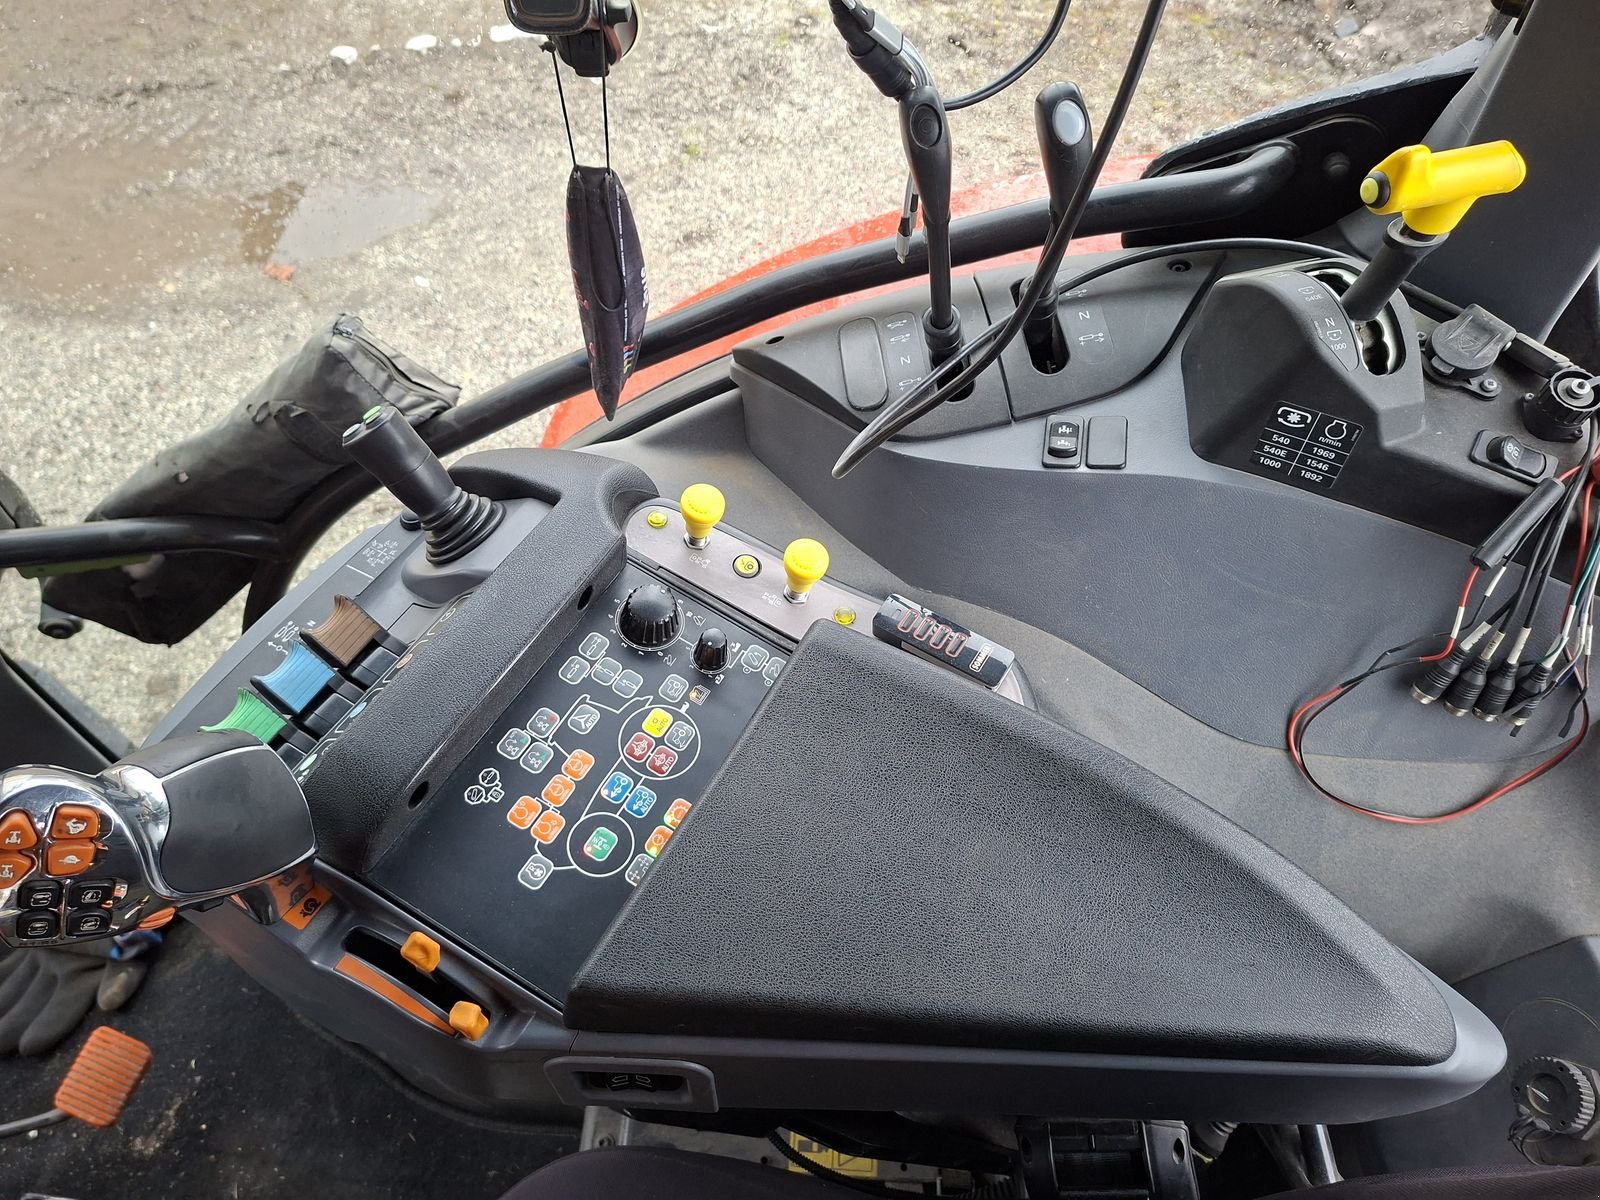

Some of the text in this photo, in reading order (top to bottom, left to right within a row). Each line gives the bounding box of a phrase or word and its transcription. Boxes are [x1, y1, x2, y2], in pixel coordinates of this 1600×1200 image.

[1078, 310, 1090, 321] N
[1324, 317, 1336, 328] N
[1330, 342, 1347, 351] 1000
[900, 355, 911, 366] N
[1271, 434, 1336, 460] 540 1969
[1318, 435, 1342, 448] n/min
[1263, 444, 1330, 471] 540E 1546
[1258, 456, 1323, 483] 1000 1892
[585, 713, 598, 729] AUTO
[656, 718, 669, 732] AUTO
[661, 756, 675, 772] AUTO
[640, 797, 654, 813] AUTO
